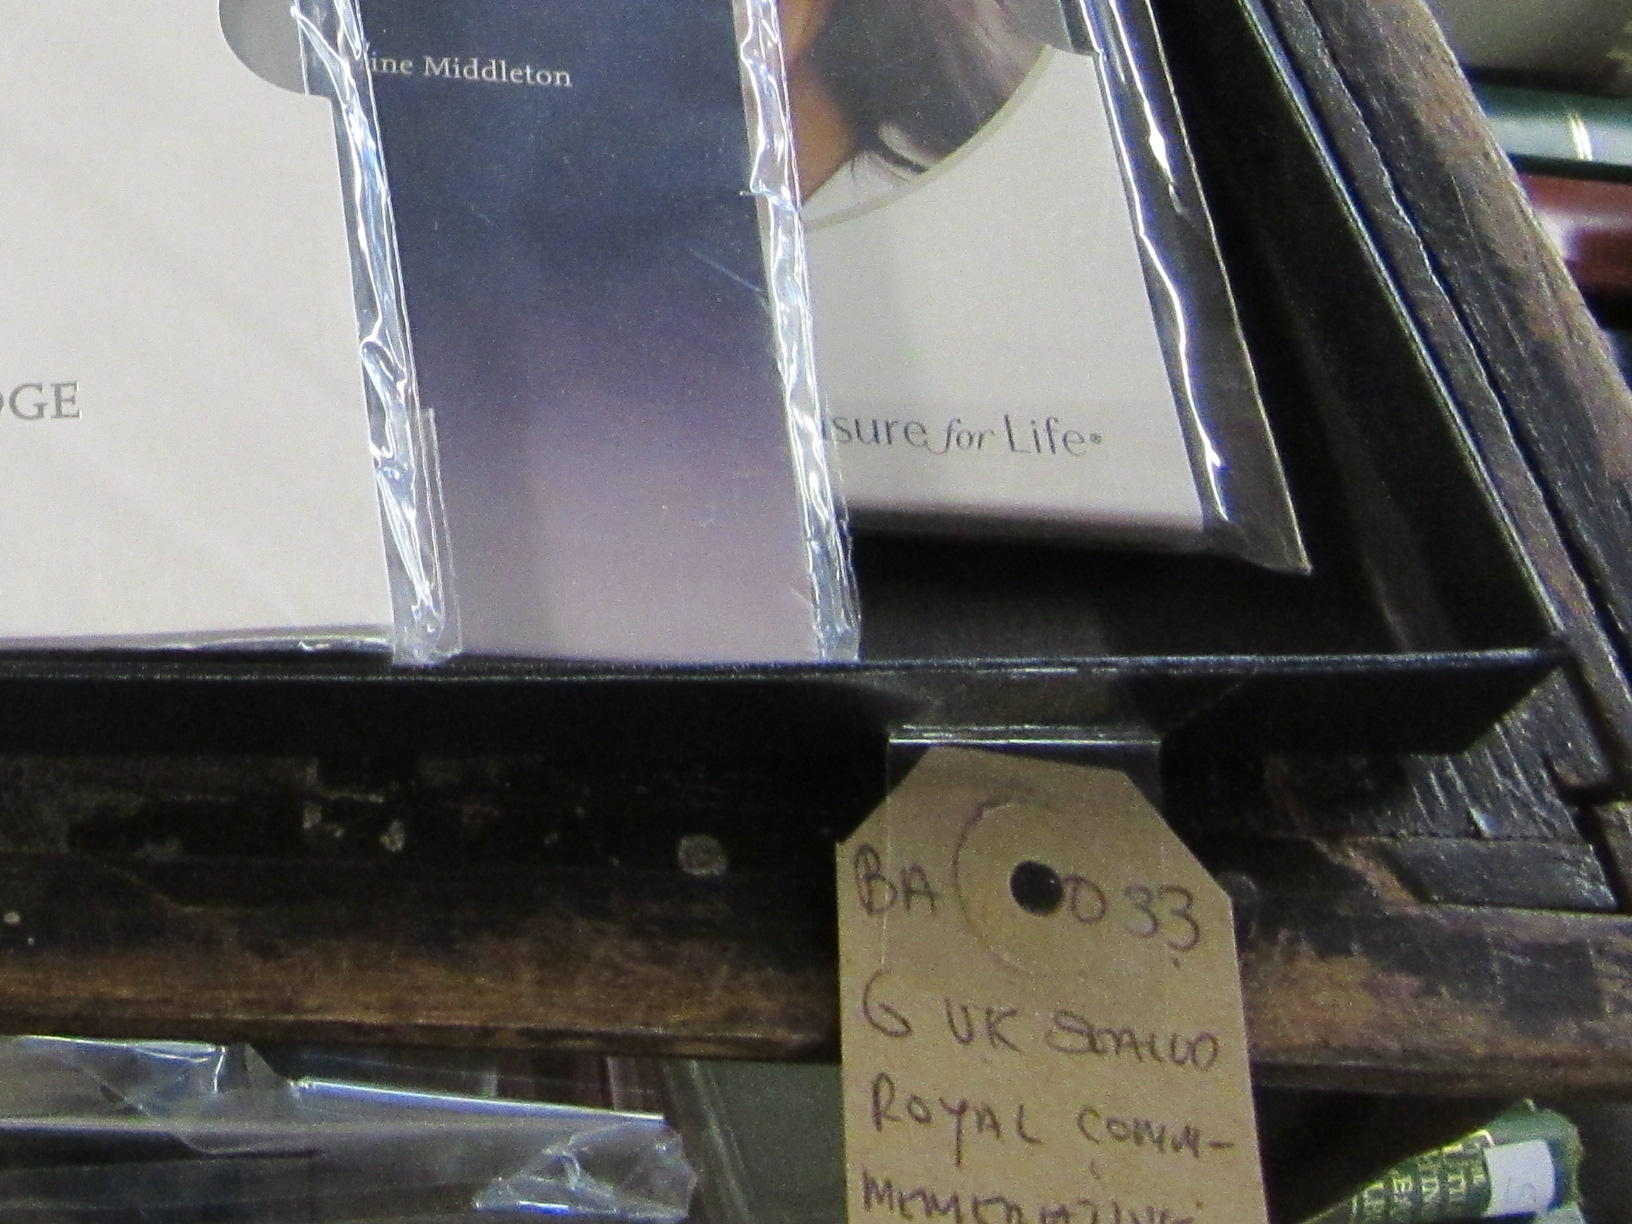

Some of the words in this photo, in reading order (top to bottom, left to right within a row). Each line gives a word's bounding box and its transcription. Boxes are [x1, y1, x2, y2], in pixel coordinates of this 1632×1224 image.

[368, 48, 414, 75] ine
[423, 53, 573, 88] Middleton
[927, 417, 996, 456] for
[944, 996, 1024, 1055] UK
[870, 1071, 1042, 1169] ROYAL
